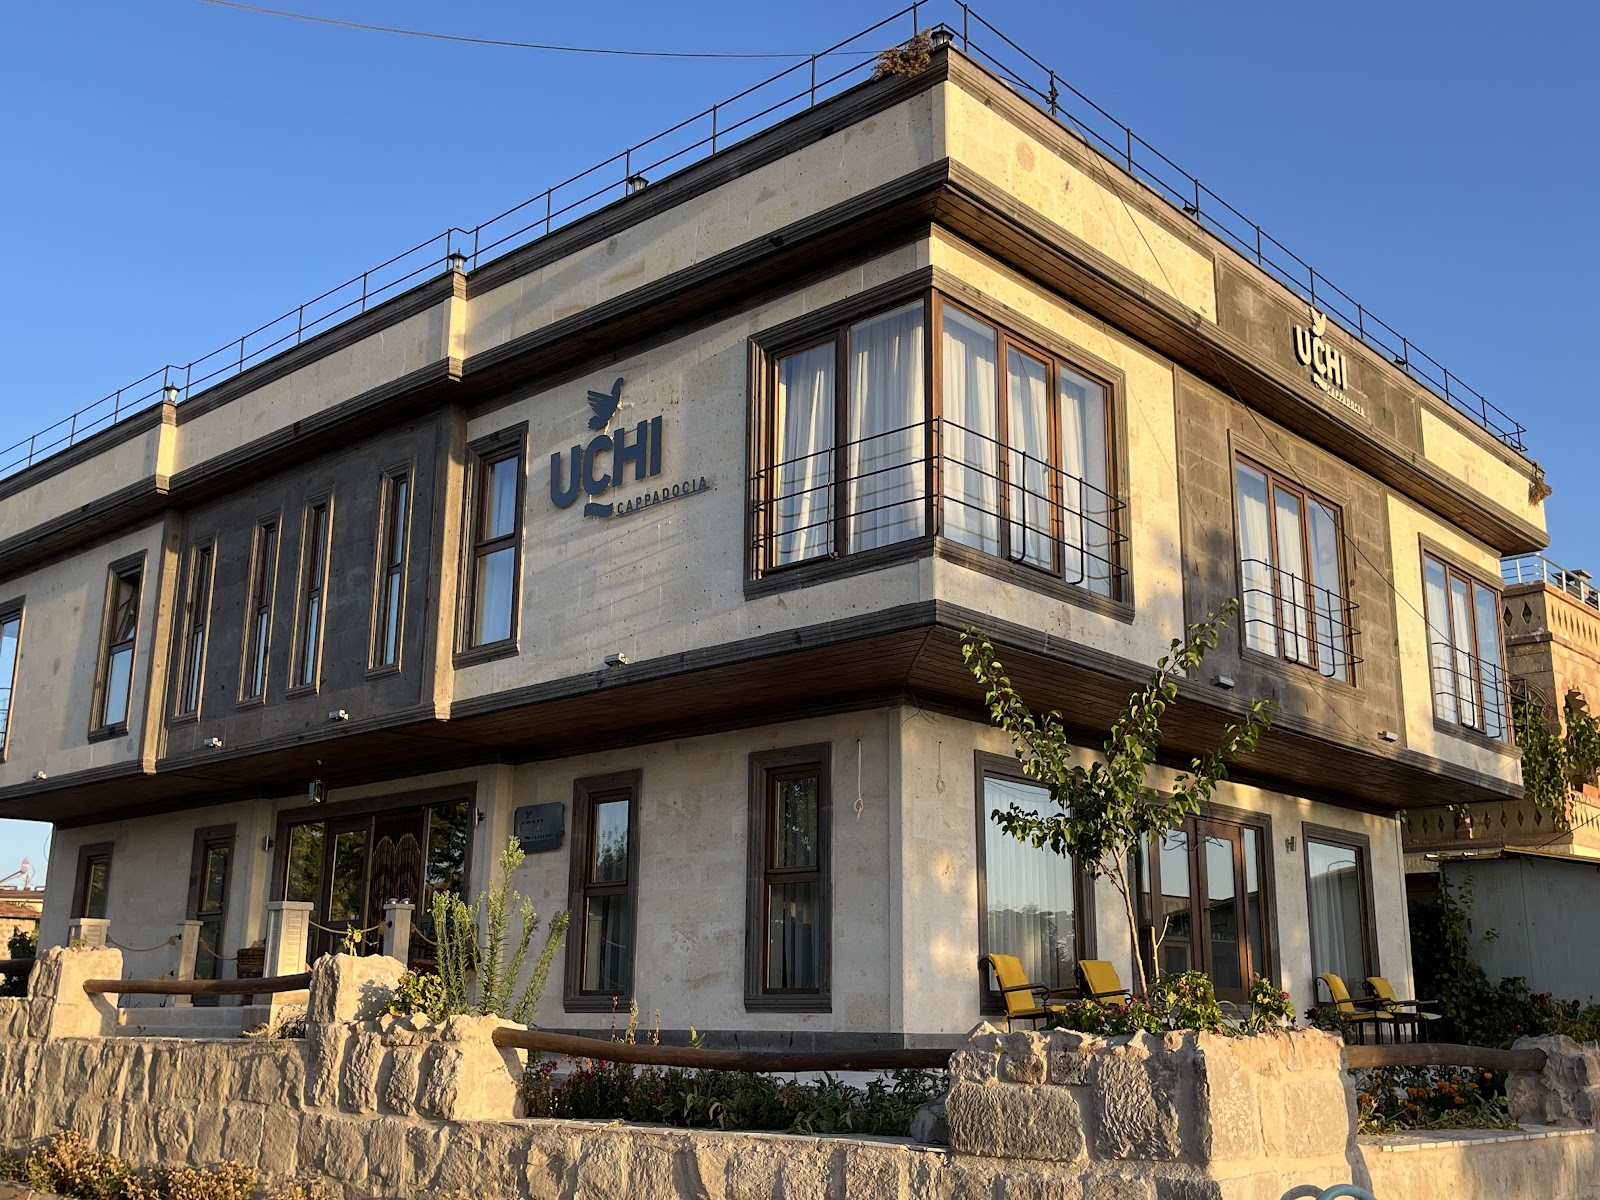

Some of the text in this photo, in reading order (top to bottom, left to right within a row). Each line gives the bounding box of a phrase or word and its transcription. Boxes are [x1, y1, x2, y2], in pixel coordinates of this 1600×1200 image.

[1295, 324, 1348, 391] UCHI
[1327, 385, 1366, 418] CAPPADOCIA
[550, 415, 662, 509] UCHI
[617, 476, 708, 515] CAPPADOCIA
